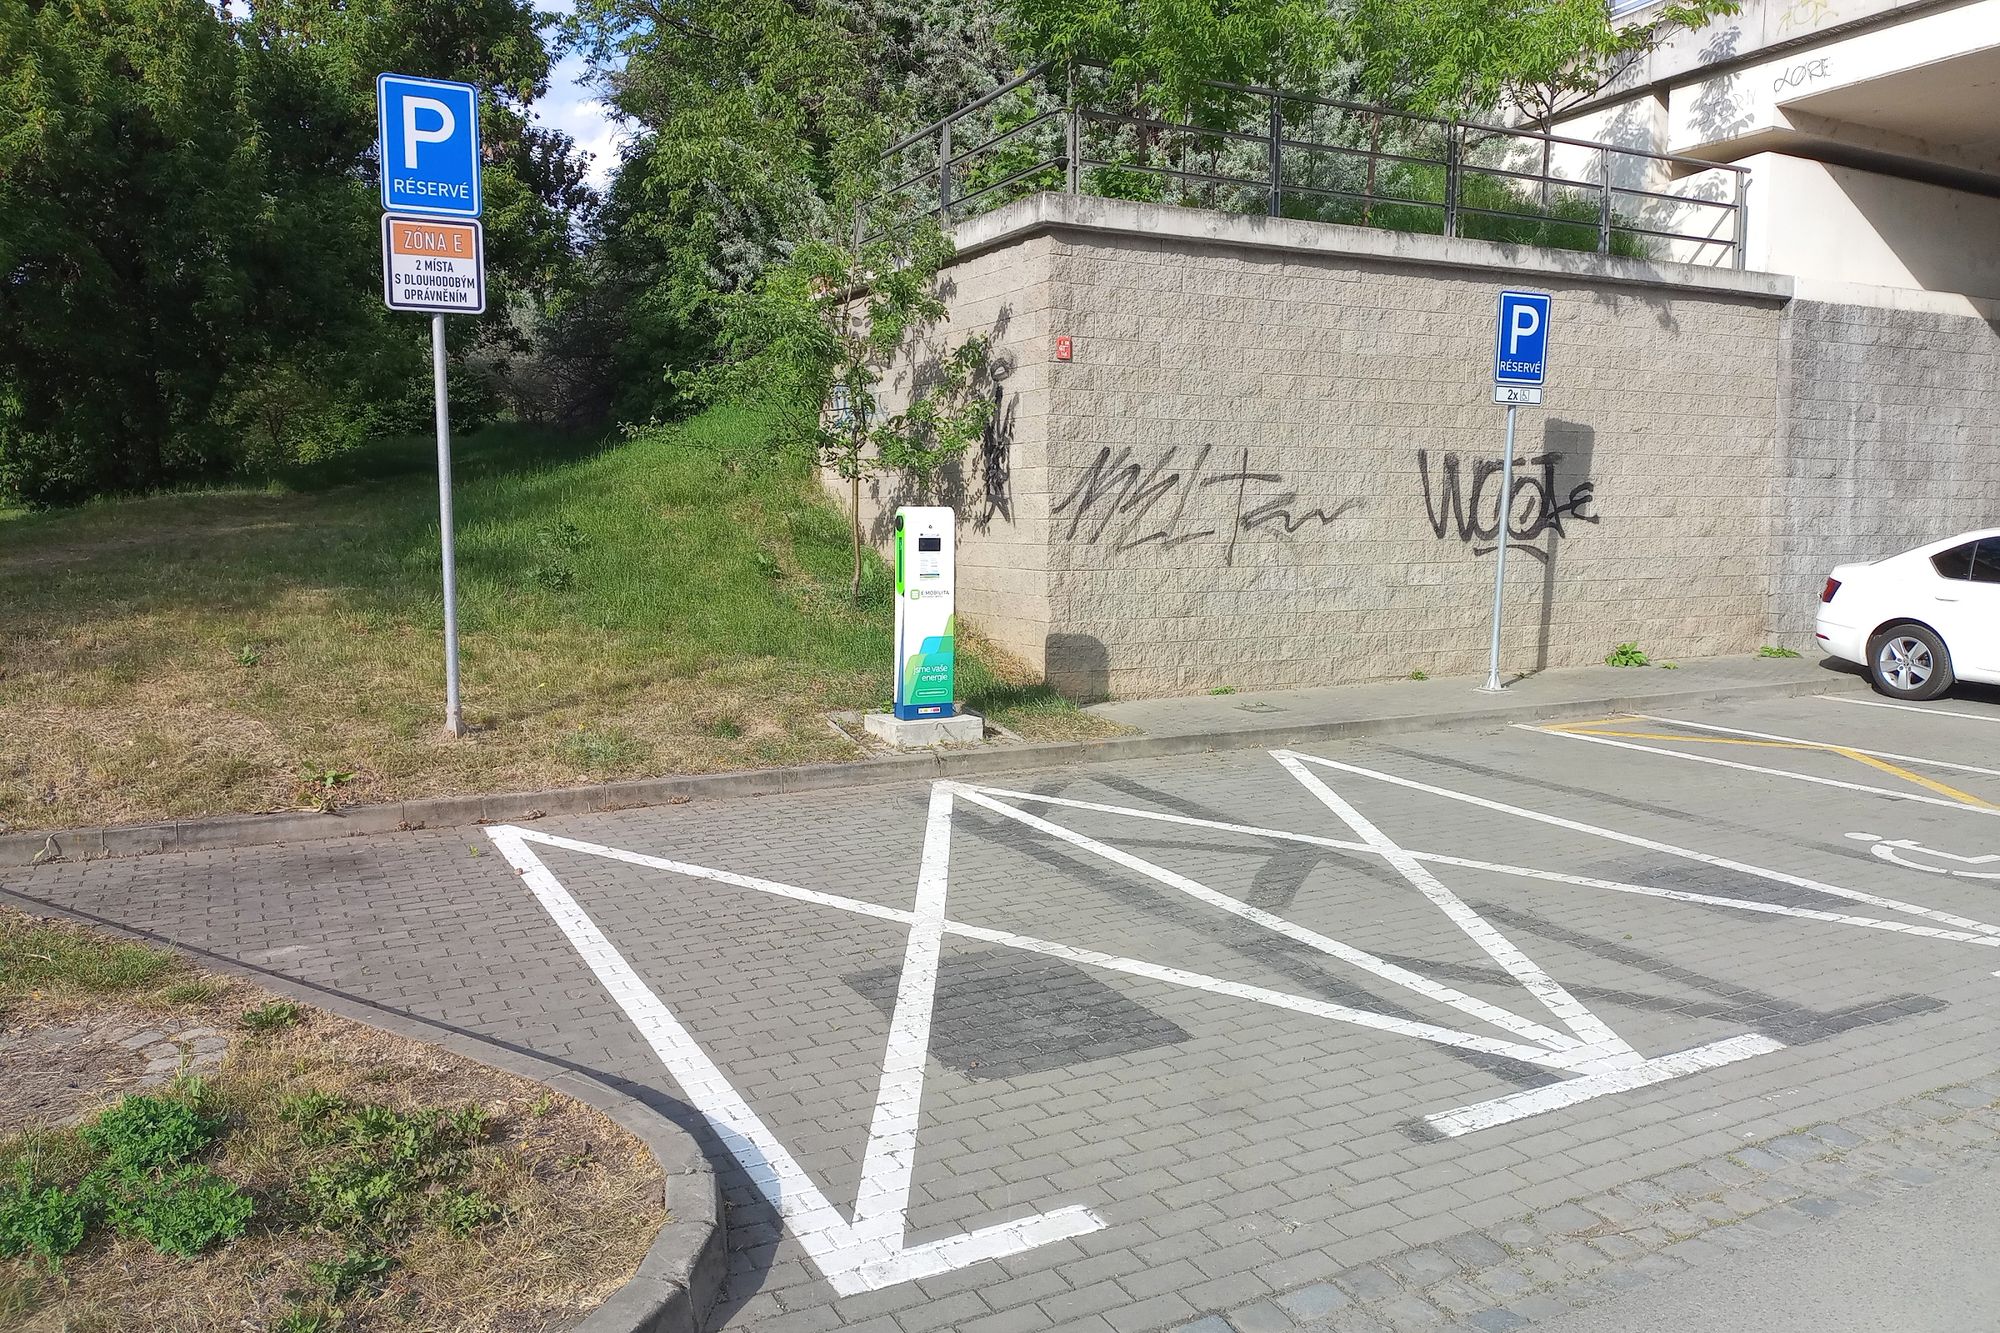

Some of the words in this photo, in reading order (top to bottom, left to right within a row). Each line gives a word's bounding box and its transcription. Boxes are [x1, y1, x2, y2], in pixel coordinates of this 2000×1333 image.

[403, 95, 455, 169] P
[393, 177, 470, 199] RÉSERVÉ
[404, 226, 447, 251] ZÓNA
[453, 234, 463, 252] E
[416, 260, 421, 271] 2
[424, 258, 454, 273] MÍSTA
[395, 273, 401, 284] S
[404, 274, 475, 289] DLOUHODOBÝM
[404, 287, 467, 303] OPRÁVNĚNÍM
[1510, 304, 1539, 354] P
[1500, 359, 1541, 374] RÉSERVÉ
[921, 673, 948, 683] energie
